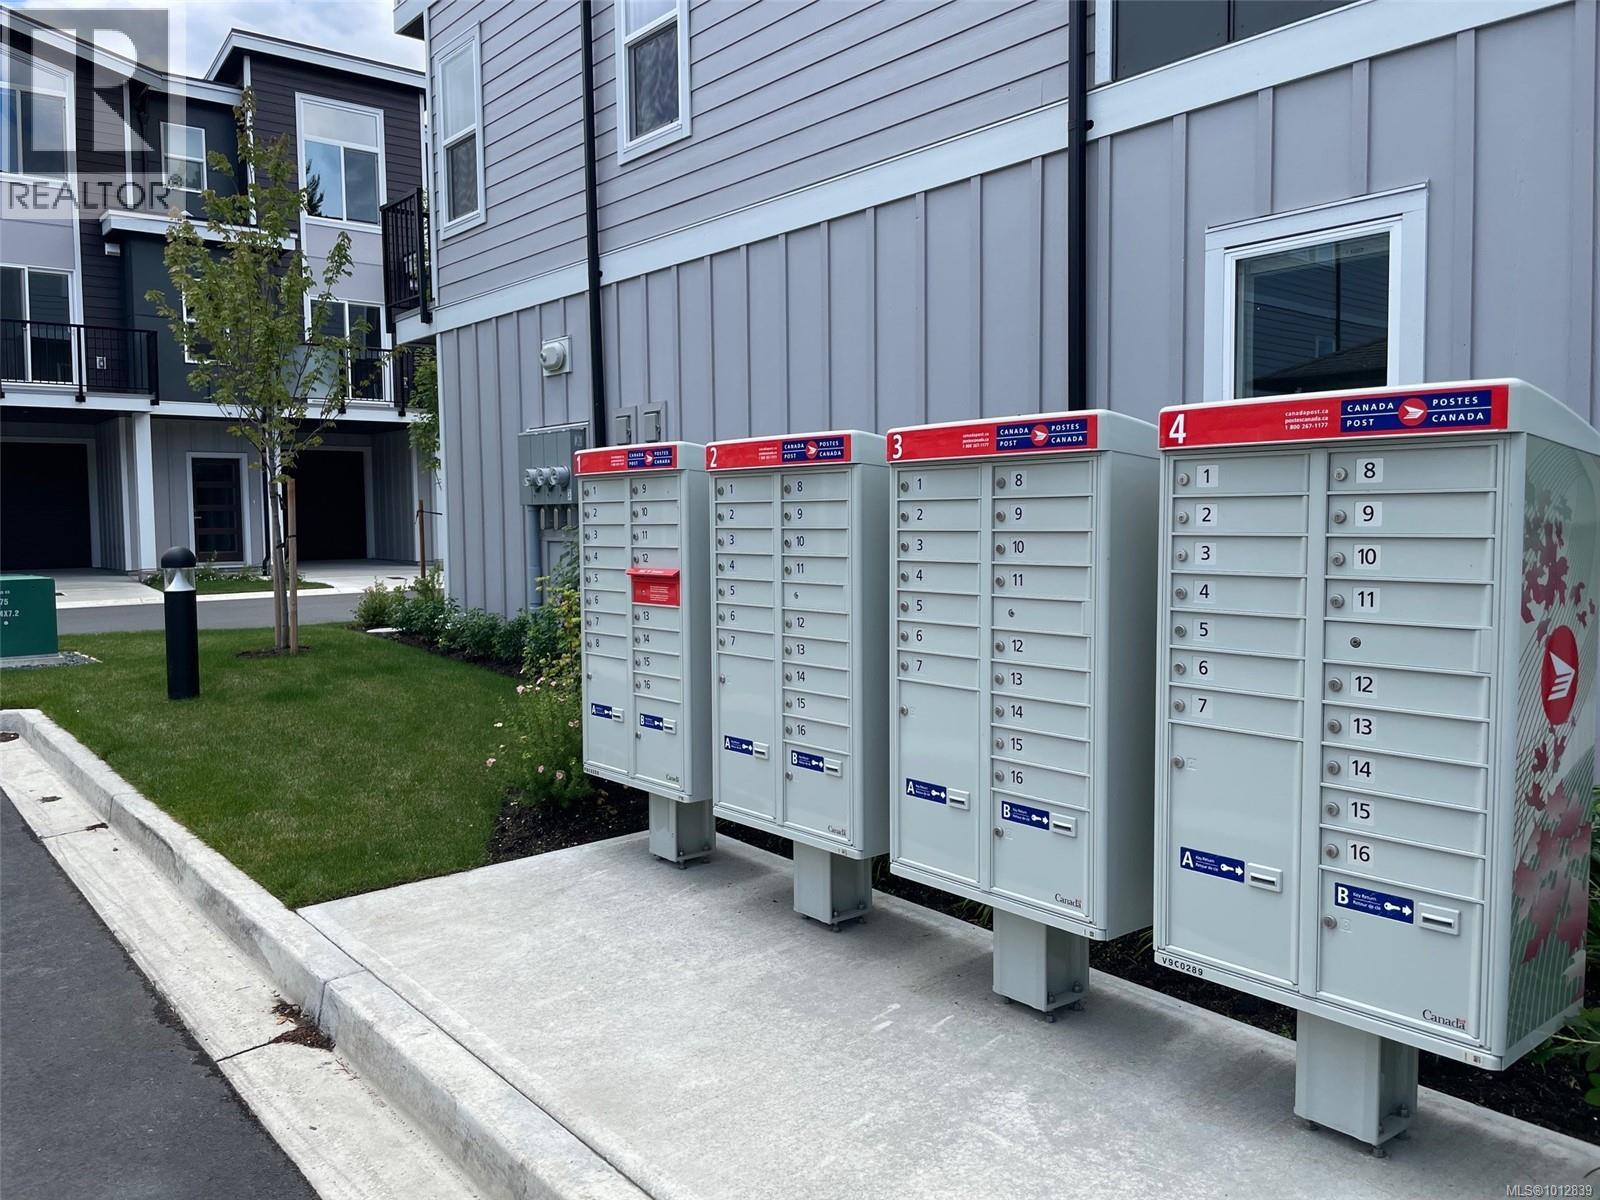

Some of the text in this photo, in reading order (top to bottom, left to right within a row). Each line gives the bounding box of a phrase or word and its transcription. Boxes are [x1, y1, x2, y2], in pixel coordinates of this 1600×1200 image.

[1347, 402, 1395, 412] CANADA
[1432, 396, 1479, 407] POSTES
[1285, 409, 1329, 417] canadapost.ca
[1432, 411, 1485, 423] CANADA
[1285, 416, 1329, 424] postescanada.ca
[1347, 418, 1375, 427] POST
[1000, 427, 1029, 436] CANADA
[1051, 423, 1080, 431] POSTES
[1168, 414, 1187, 444] 4
[1051, 435, 1083, 444] CANADA
[892, 433, 903, 459] 3
[710, 447, 717, 468] 2
[576, 455, 581, 473] 1
[1203, 468, 1210, 484] 1
[1363, 462, 1376, 479] 8
[797, 480, 803, 492] 8
[917, 478, 922, 490] 1
[1015, 473, 1023, 487] 8
[641, 483, 647, 494] 9
[729, 483, 733, 494] 1
[593, 507, 598, 518] 2
[641, 506, 648, 517] 10
[729, 509, 735, 520] 2
[797, 508, 803, 520] 9
[916, 508, 923, 521] 2
[1014, 507, 1023, 521] 9
[1202, 507, 1211, 522] 2
[1362, 505, 1374, 522] 9
[593, 529, 598, 540] 3
[641, 530, 648, 540] 11
[729, 534, 735, 545] 3
[796, 535, 805, 547] 10
[916, 538, 923, 551] 3
[1012, 540, 1025, 554] 10
[593, 551, 598, 561] 4
[642, 553, 649, 563] 12
[1201, 545, 1210, 561] 3
[1357, 548, 1377, 565] 10
[729, 559, 735, 570] 4
[796, 562, 804, 574] 11
[594, 573, 599, 583] 5
[915, 569, 923, 581] 4
[1012, 573, 1023, 587] 11
[730, 584, 735, 596] 5
[1199, 583, 1210, 599] 4
[594, 595, 599, 605] 6
[1357, 590, 1374, 608] 11
[916, 599, 923, 612] 5
[595, 616, 600, 626] 7
[642, 610, 650, 621] 13
[730, 610, 736, 621] 6
[796, 616, 805, 628] 12
[1199, 621, 1209, 637] 5
[643, 633, 650, 643] 14
[730, 635, 736, 646] 7
[916, 629, 923, 642] 6
[595, 638, 600, 648] 8
[796, 643, 805, 655] 13
[1011, 639, 1024, 653] 12
[643, 656, 651, 667] 15
[916, 659, 923, 672] 7
[1198, 660, 1209, 676] 6
[796, 670, 806, 682] 14
[1010, 672, 1023, 686] 13
[643, 679, 651, 690] 16
[1355, 675, 1373, 694] 12
[591, 704, 597, 714] A
[796, 697, 806, 709] 15
[1198, 697, 1207, 713] 7
[1010, 704, 1023, 719] 14
[640, 715, 645, 725] B
[1353, 717, 1372, 735] 13
[796, 724, 806, 736] 16
[725, 737, 731, 749] A
[1010, 737, 1023, 752] 15
[792, 752, 798, 764] B
[1351, 759, 1372, 778] 14
[1010, 770, 1024, 785] 16
[907, 781, 915, 794] A
[1003, 803, 1011, 818] B
[1351, 801, 1371, 820] 15
[1350, 843, 1370, 862] 16
[1182, 851, 1194, 868] A
[1054, 892, 1082, 909] Canada
[1337, 886, 1349, 905] B
[1161, 956, 1203, 976] V9C0289
[1422, 1008, 1466, 1031] Canada
